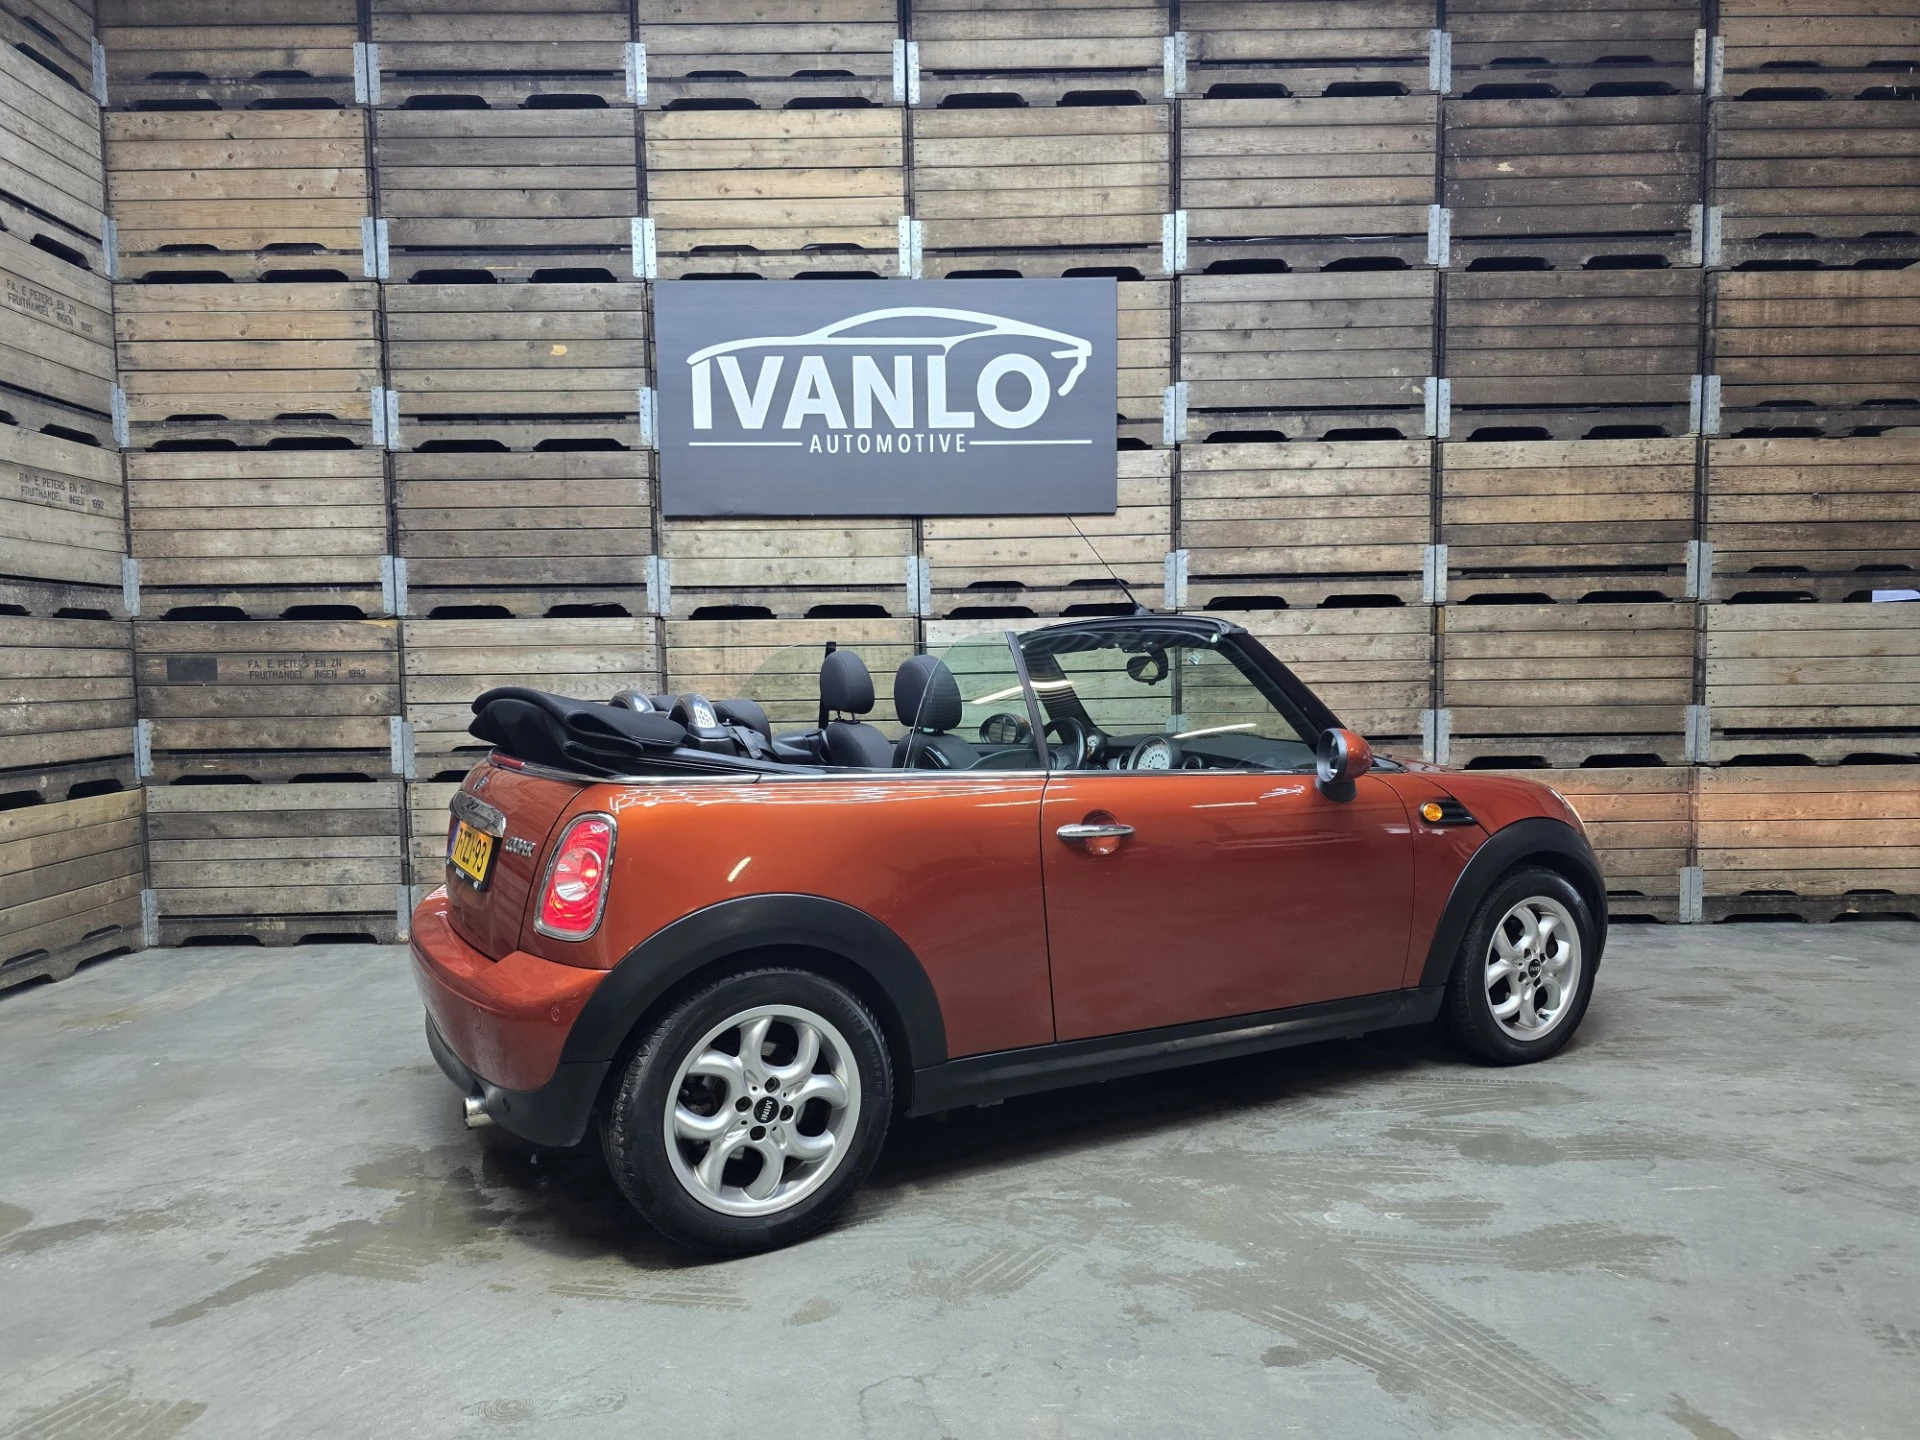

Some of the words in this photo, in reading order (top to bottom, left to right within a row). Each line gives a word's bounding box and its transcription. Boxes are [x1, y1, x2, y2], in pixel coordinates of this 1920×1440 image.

[29, 289, 54, 307] PETERS
[690, 353, 1051, 429] IVANLO
[809, 433, 966, 454] AUTOMOTIVE
[42, 478, 66, 491] PETERS
[277, 659, 309, 669] PETERS
[314, 658, 326, 668] EN
[330, 658, 342, 668] ZN
[249, 669, 305, 680] FRUITHANDEL
[313, 668, 338, 679] INGEN
[348, 668, 367, 679] 1992
[760, 1099, 774, 1121] MINI
